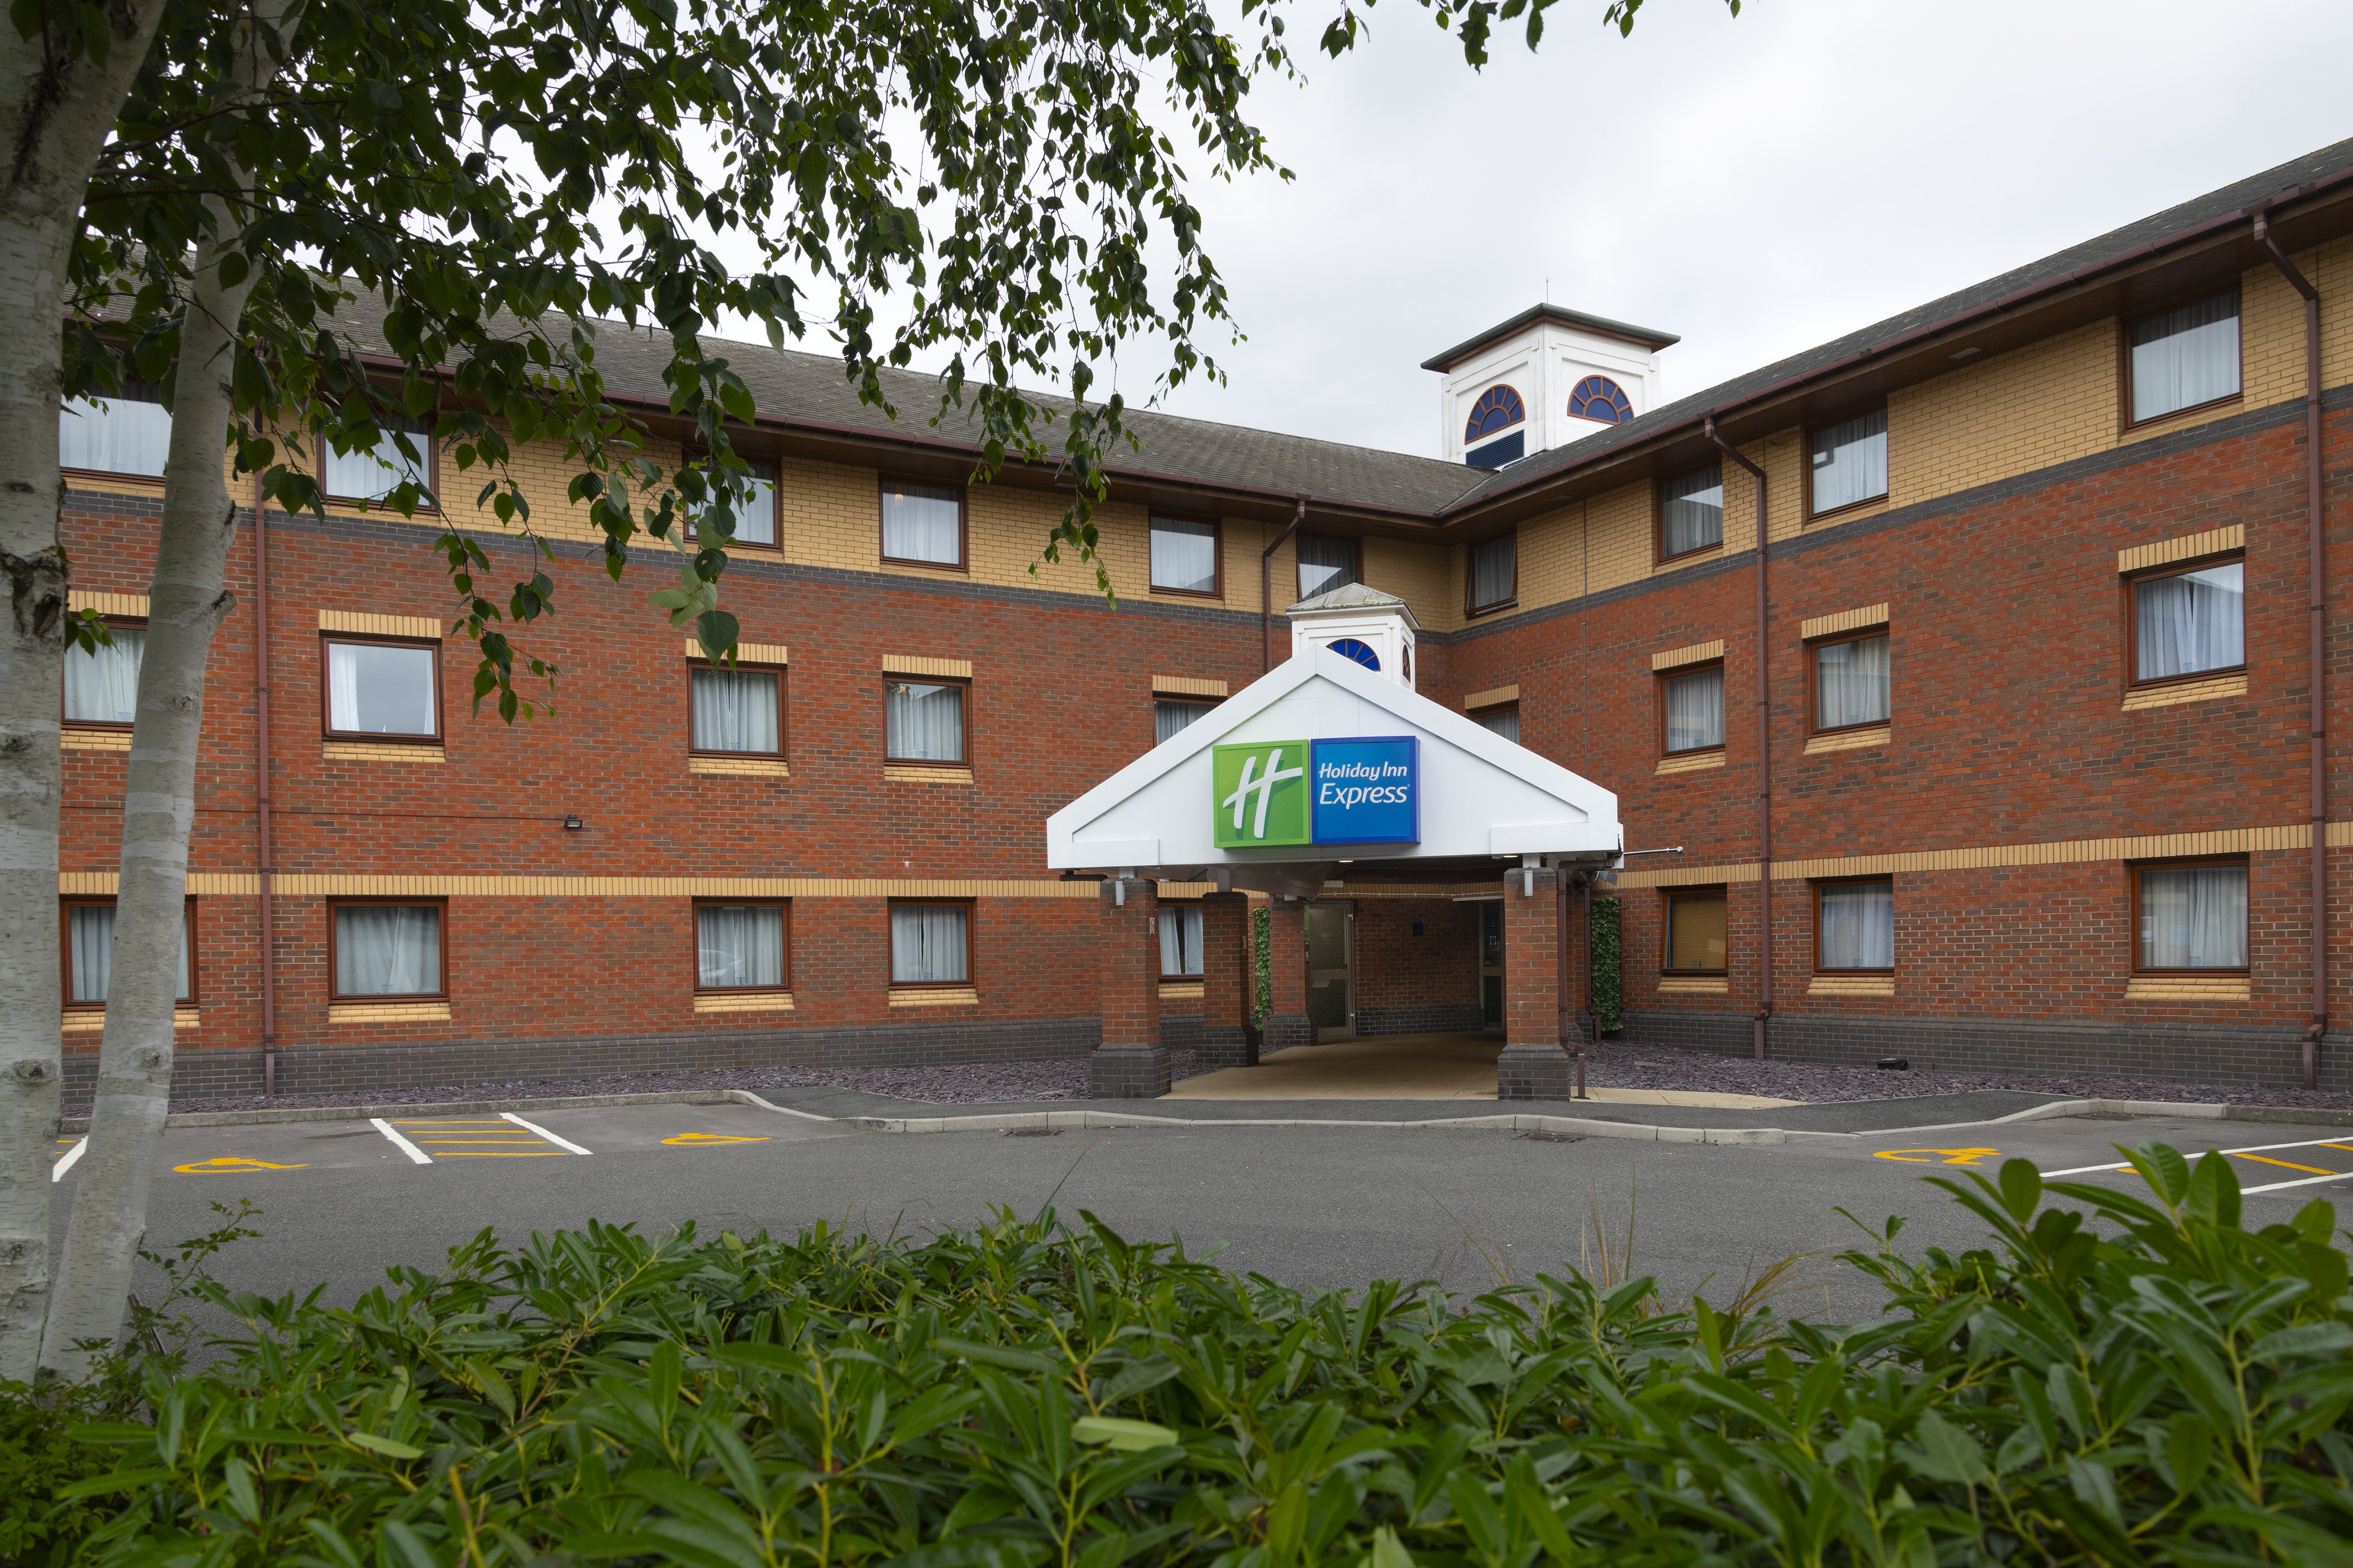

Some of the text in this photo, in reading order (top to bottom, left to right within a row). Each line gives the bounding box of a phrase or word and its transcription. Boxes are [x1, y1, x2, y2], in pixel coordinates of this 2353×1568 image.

[1319, 761, 1407, 781] Holiday Inn
[1320, 783, 1408, 810] Express
